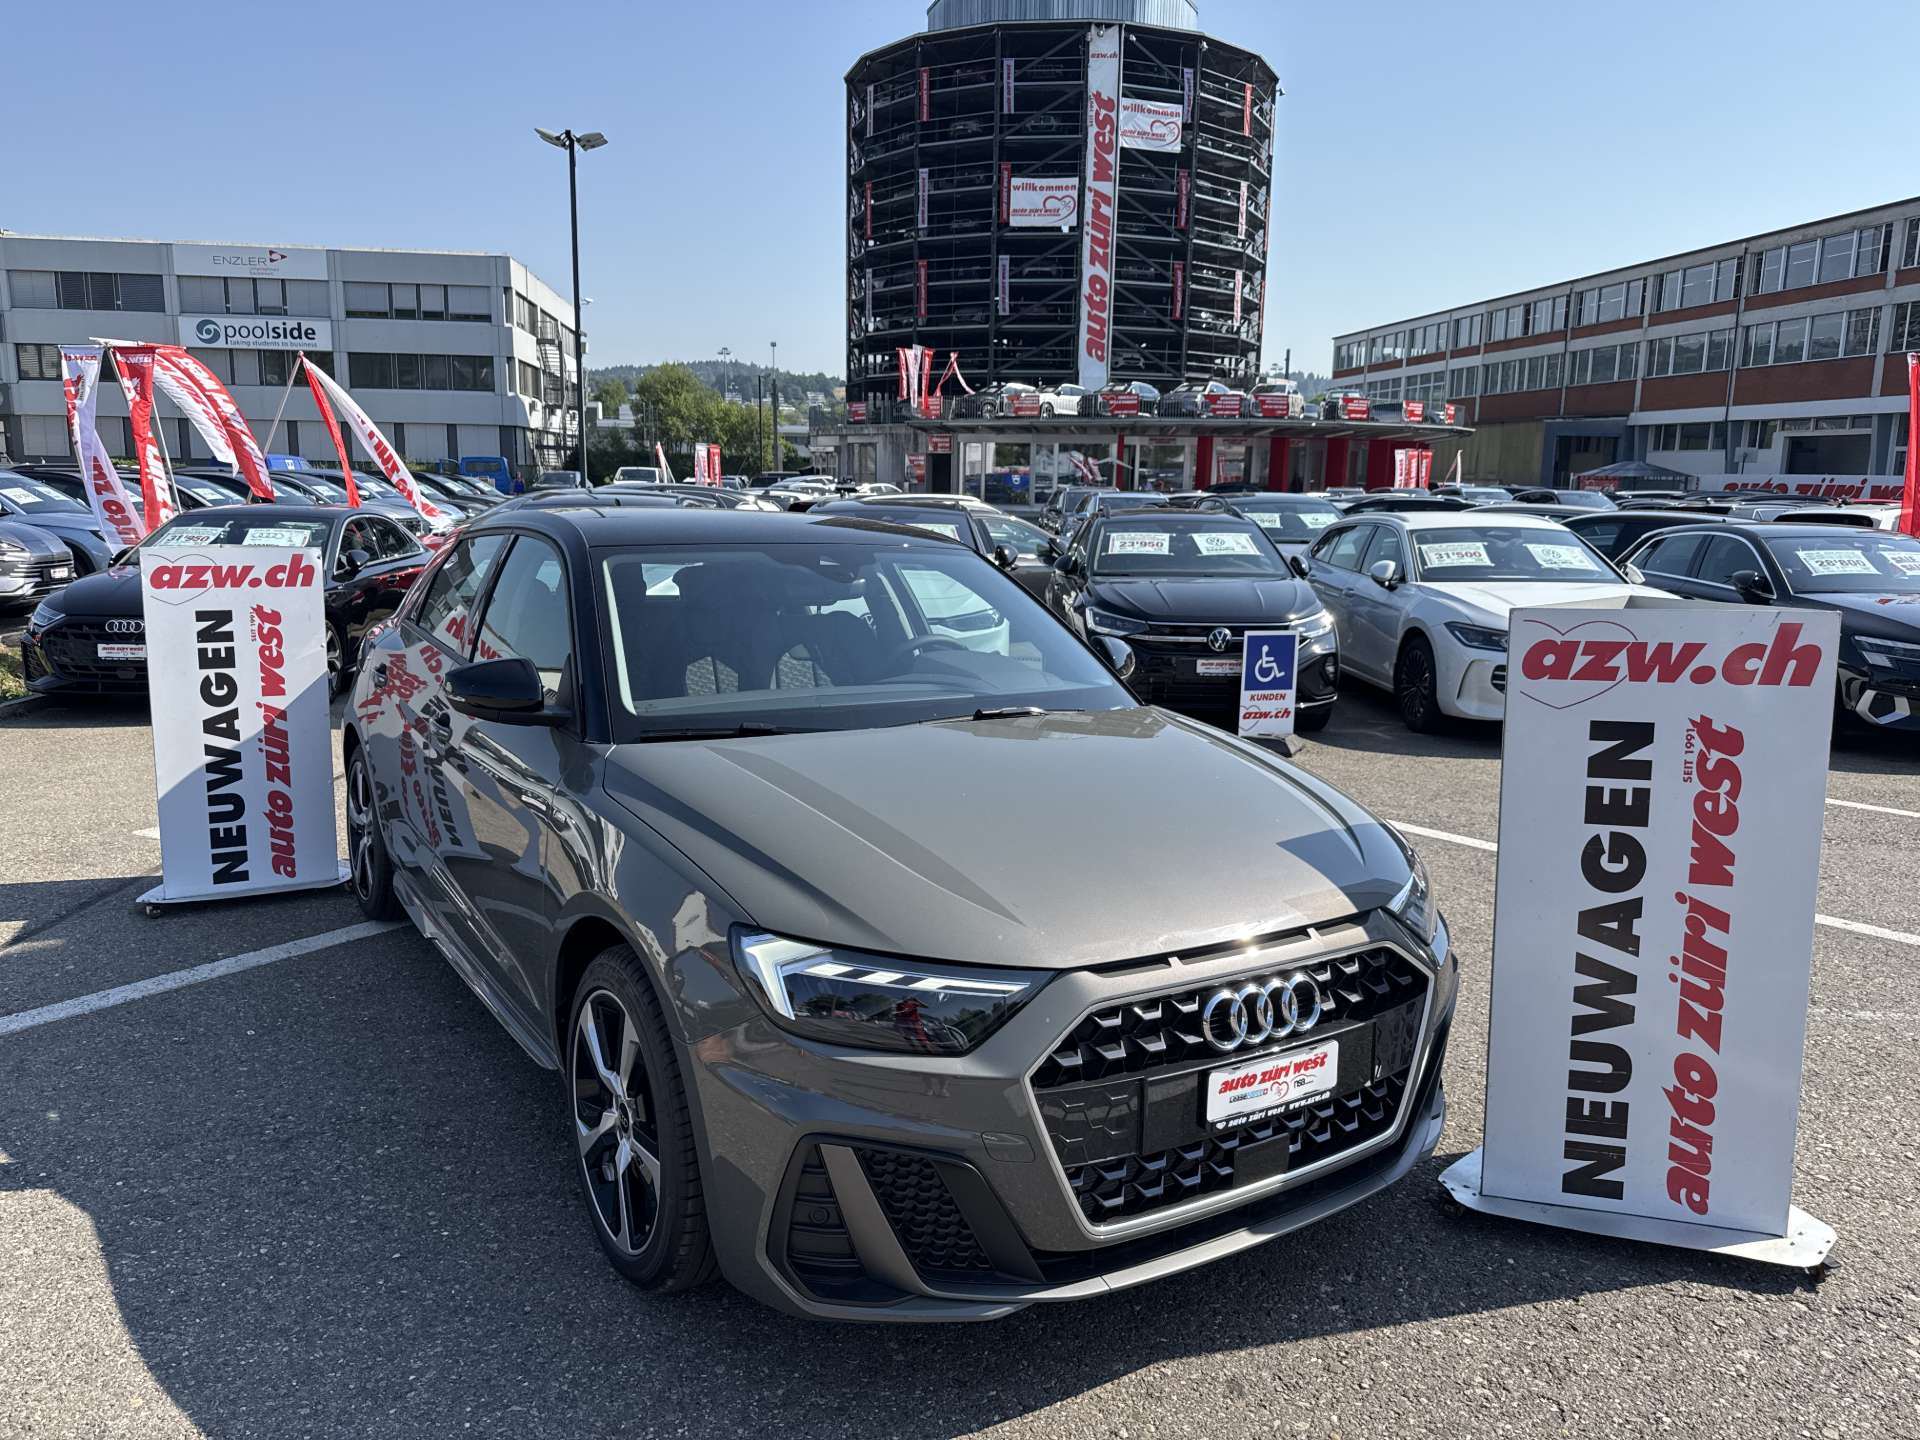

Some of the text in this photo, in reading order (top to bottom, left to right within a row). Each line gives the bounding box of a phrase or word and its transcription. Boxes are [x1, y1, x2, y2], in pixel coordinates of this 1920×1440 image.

[1122, 103, 1181, 118] willkommen
[1012, 182, 1077, 192] willkommen
[1083, 89, 1116, 363] auto züri west
[212, 255, 267, 266] ENZLER
[224, 321, 316, 345] poolside
[252, 340, 281, 348] students
[290, 341, 318, 349] business
[166, 533, 210, 543] 31'950
[149, 553, 316, 590] azw.ch
[1520, 622, 1824, 689] azw.ch
[1249, 693, 1287, 702] KUNDEN
[1242, 707, 1292, 720] azw.ch
[194, 608, 250, 886] NEUWAGEN
[252, 602, 297, 880] auto züri west
[1682, 728, 1695, 783] SEIT 1991
[1561, 718, 1656, 1203] NEUWAGEN
[1661, 713, 1746, 1217] auto züri west
[1218, 1051, 1329, 1095] auto züri west
[1228, 1116, 1248, 1127] auto
[1267, 1105, 1286, 1117] west
